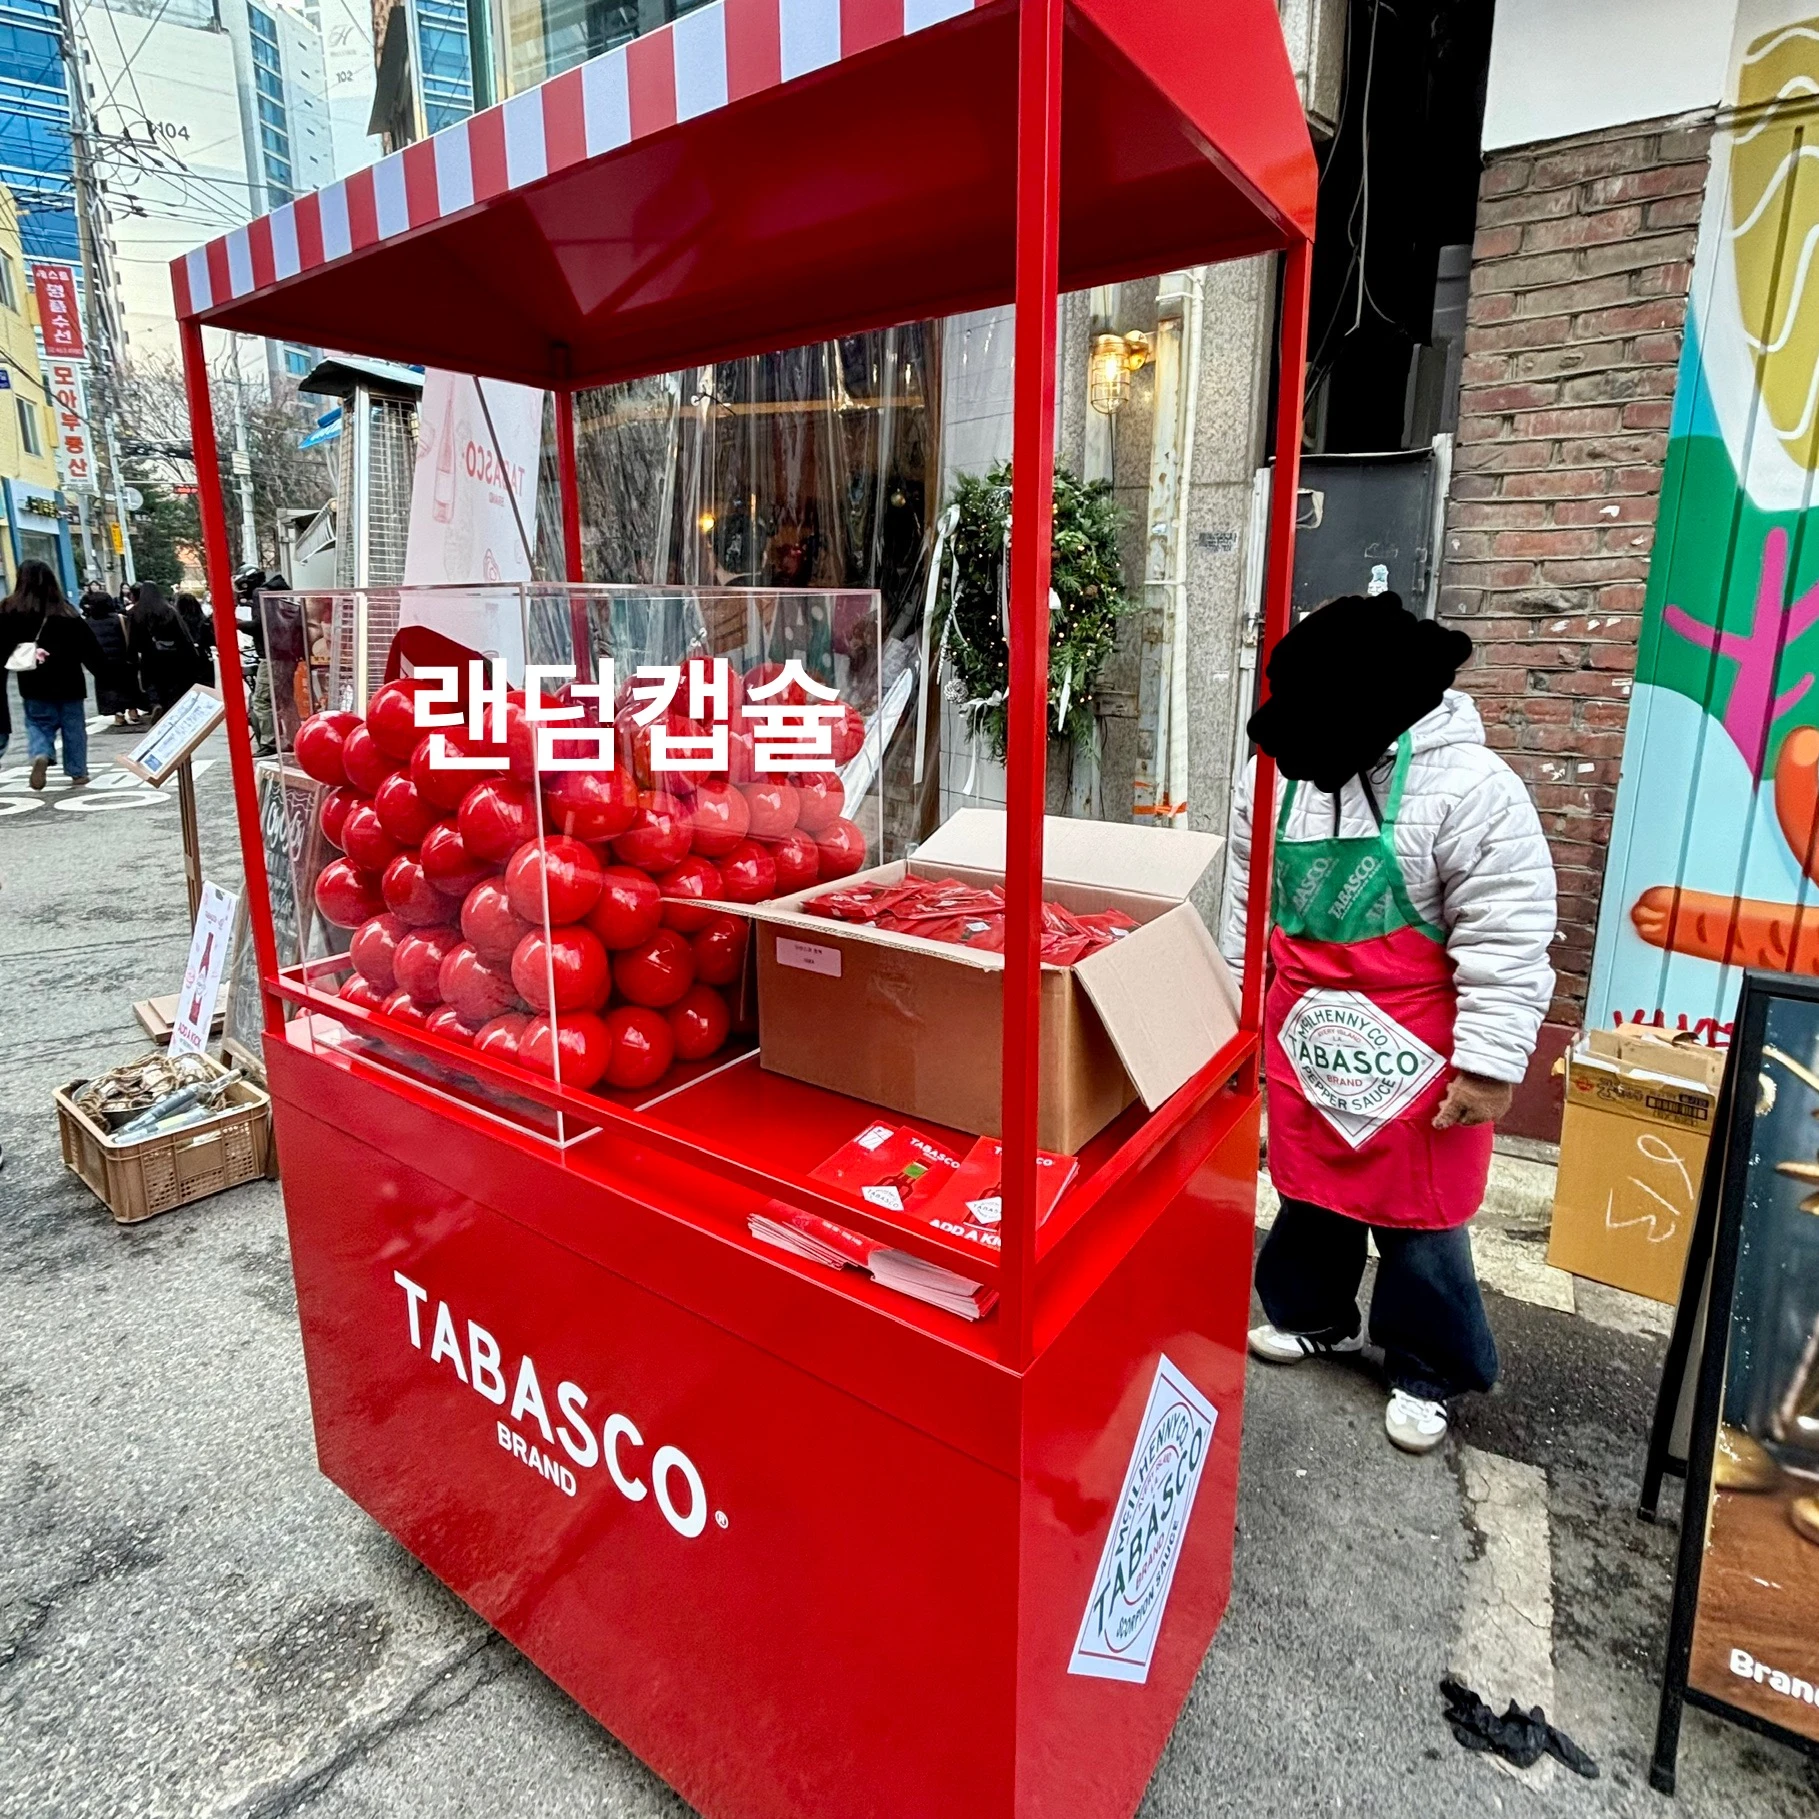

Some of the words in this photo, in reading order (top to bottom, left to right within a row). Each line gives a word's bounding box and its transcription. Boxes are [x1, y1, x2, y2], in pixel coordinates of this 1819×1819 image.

[336, 69, 354, 84] 102
[54, 366, 88, 478] 모아부동산
[1327, 855, 1377, 920] TABASCO
[1367, 1027, 1388, 1050] CO.
[1302, 1065, 1348, 1111] PEPPER
[1351, 1077, 1396, 1111] SAUCE
[1326, 1074, 1363, 1087] BRAND
[910, 1137, 961, 1169] TABASCO
[929, 1218, 965, 1237] ADD
[964, 1230, 979, 1242] A
[973, 1203, 999, 1214] TABAS
[496, 1420, 577, 1497] BRAND
[1094, 1427, 1203, 1638] TABASCO
[1155, 1520, 1179, 1587] SAUCE
[1135, 1532, 1165, 1592] BRAND
[1729, 1648, 1819, 1709] Bran
